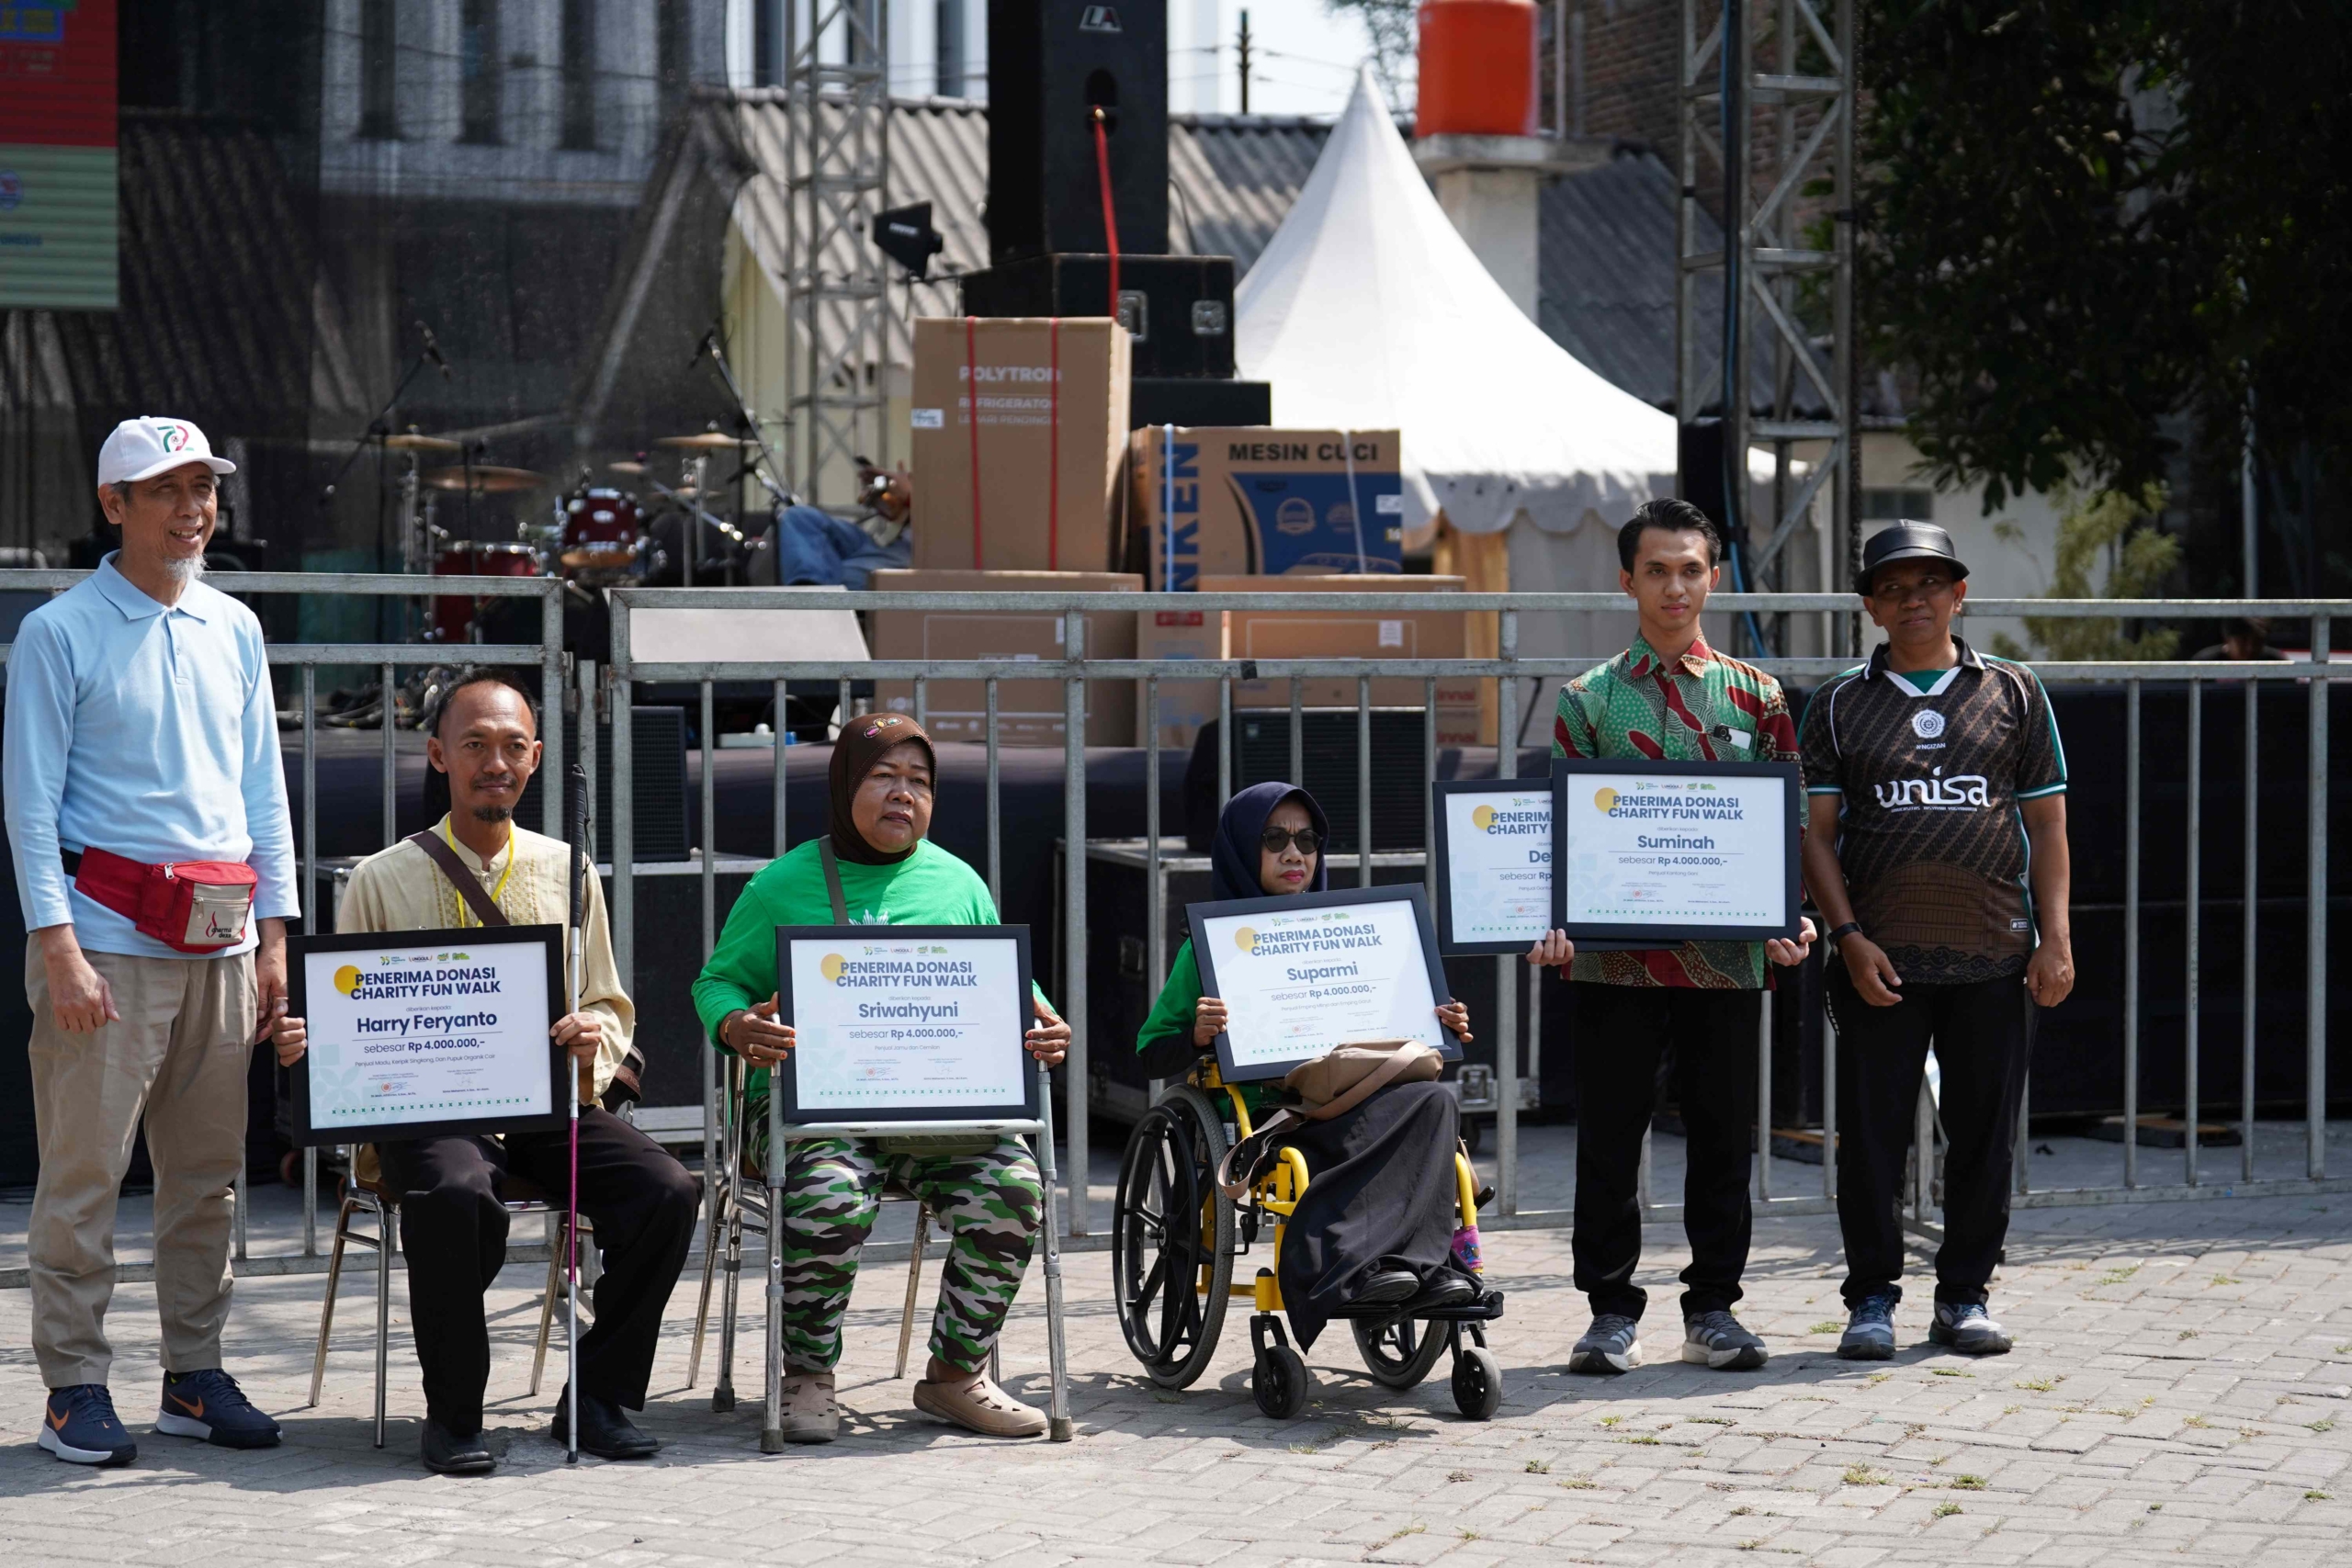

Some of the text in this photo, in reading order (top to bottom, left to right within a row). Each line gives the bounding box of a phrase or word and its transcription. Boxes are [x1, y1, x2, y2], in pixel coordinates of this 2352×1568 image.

[958, 397, 1059, 409] RFRIGERATO
[1228, 443, 1377, 460] MESIN CUCI
[1874, 765, 1991, 808] unisa
[1612, 795, 1739, 808] PENERIMA DONASI
[1491, 811, 1553, 823] PENERIM
[1608, 807, 1744, 820] CHARITY FUN WALK
[1487, 824, 1548, 835] CHARITY
[1637, 834, 1714, 850] Suminah
[1529, 850, 1553, 863] De
[1618, 856, 1656, 864] sebesar
[1657, 856, 1671, 866] Rp
[1499, 872, 1553, 882] sebesar Rp
[1252, 923, 1376, 945] PENERIMA DONASI
[1250, 935, 1383, 957] CHARITY FUN WALK
[840, 961, 972, 975] PENERIMA DONASI
[1286, 962, 1359, 983] Suparmi
[355, 966, 495, 986] PENERIMA DONASI
[836, 974, 978, 987] CHARITY FUN WALK
[350, 980, 502, 1000] CHARITY FUN WALK
[1271, 990, 1307, 1001] sebesar
[1309, 989, 1322, 999] Rp
[858, 1001, 958, 1022] Sriwahyuni
[356, 1011, 497, 1036] Harry Feryanto
[849, 1029, 888, 1039] sebesar
[890, 1030, 904, 1041] Rp
[364, 1038, 485, 1054] sebesar Rp 4.000.000,-
[447, 1055, 462, 1063] Pupuk
